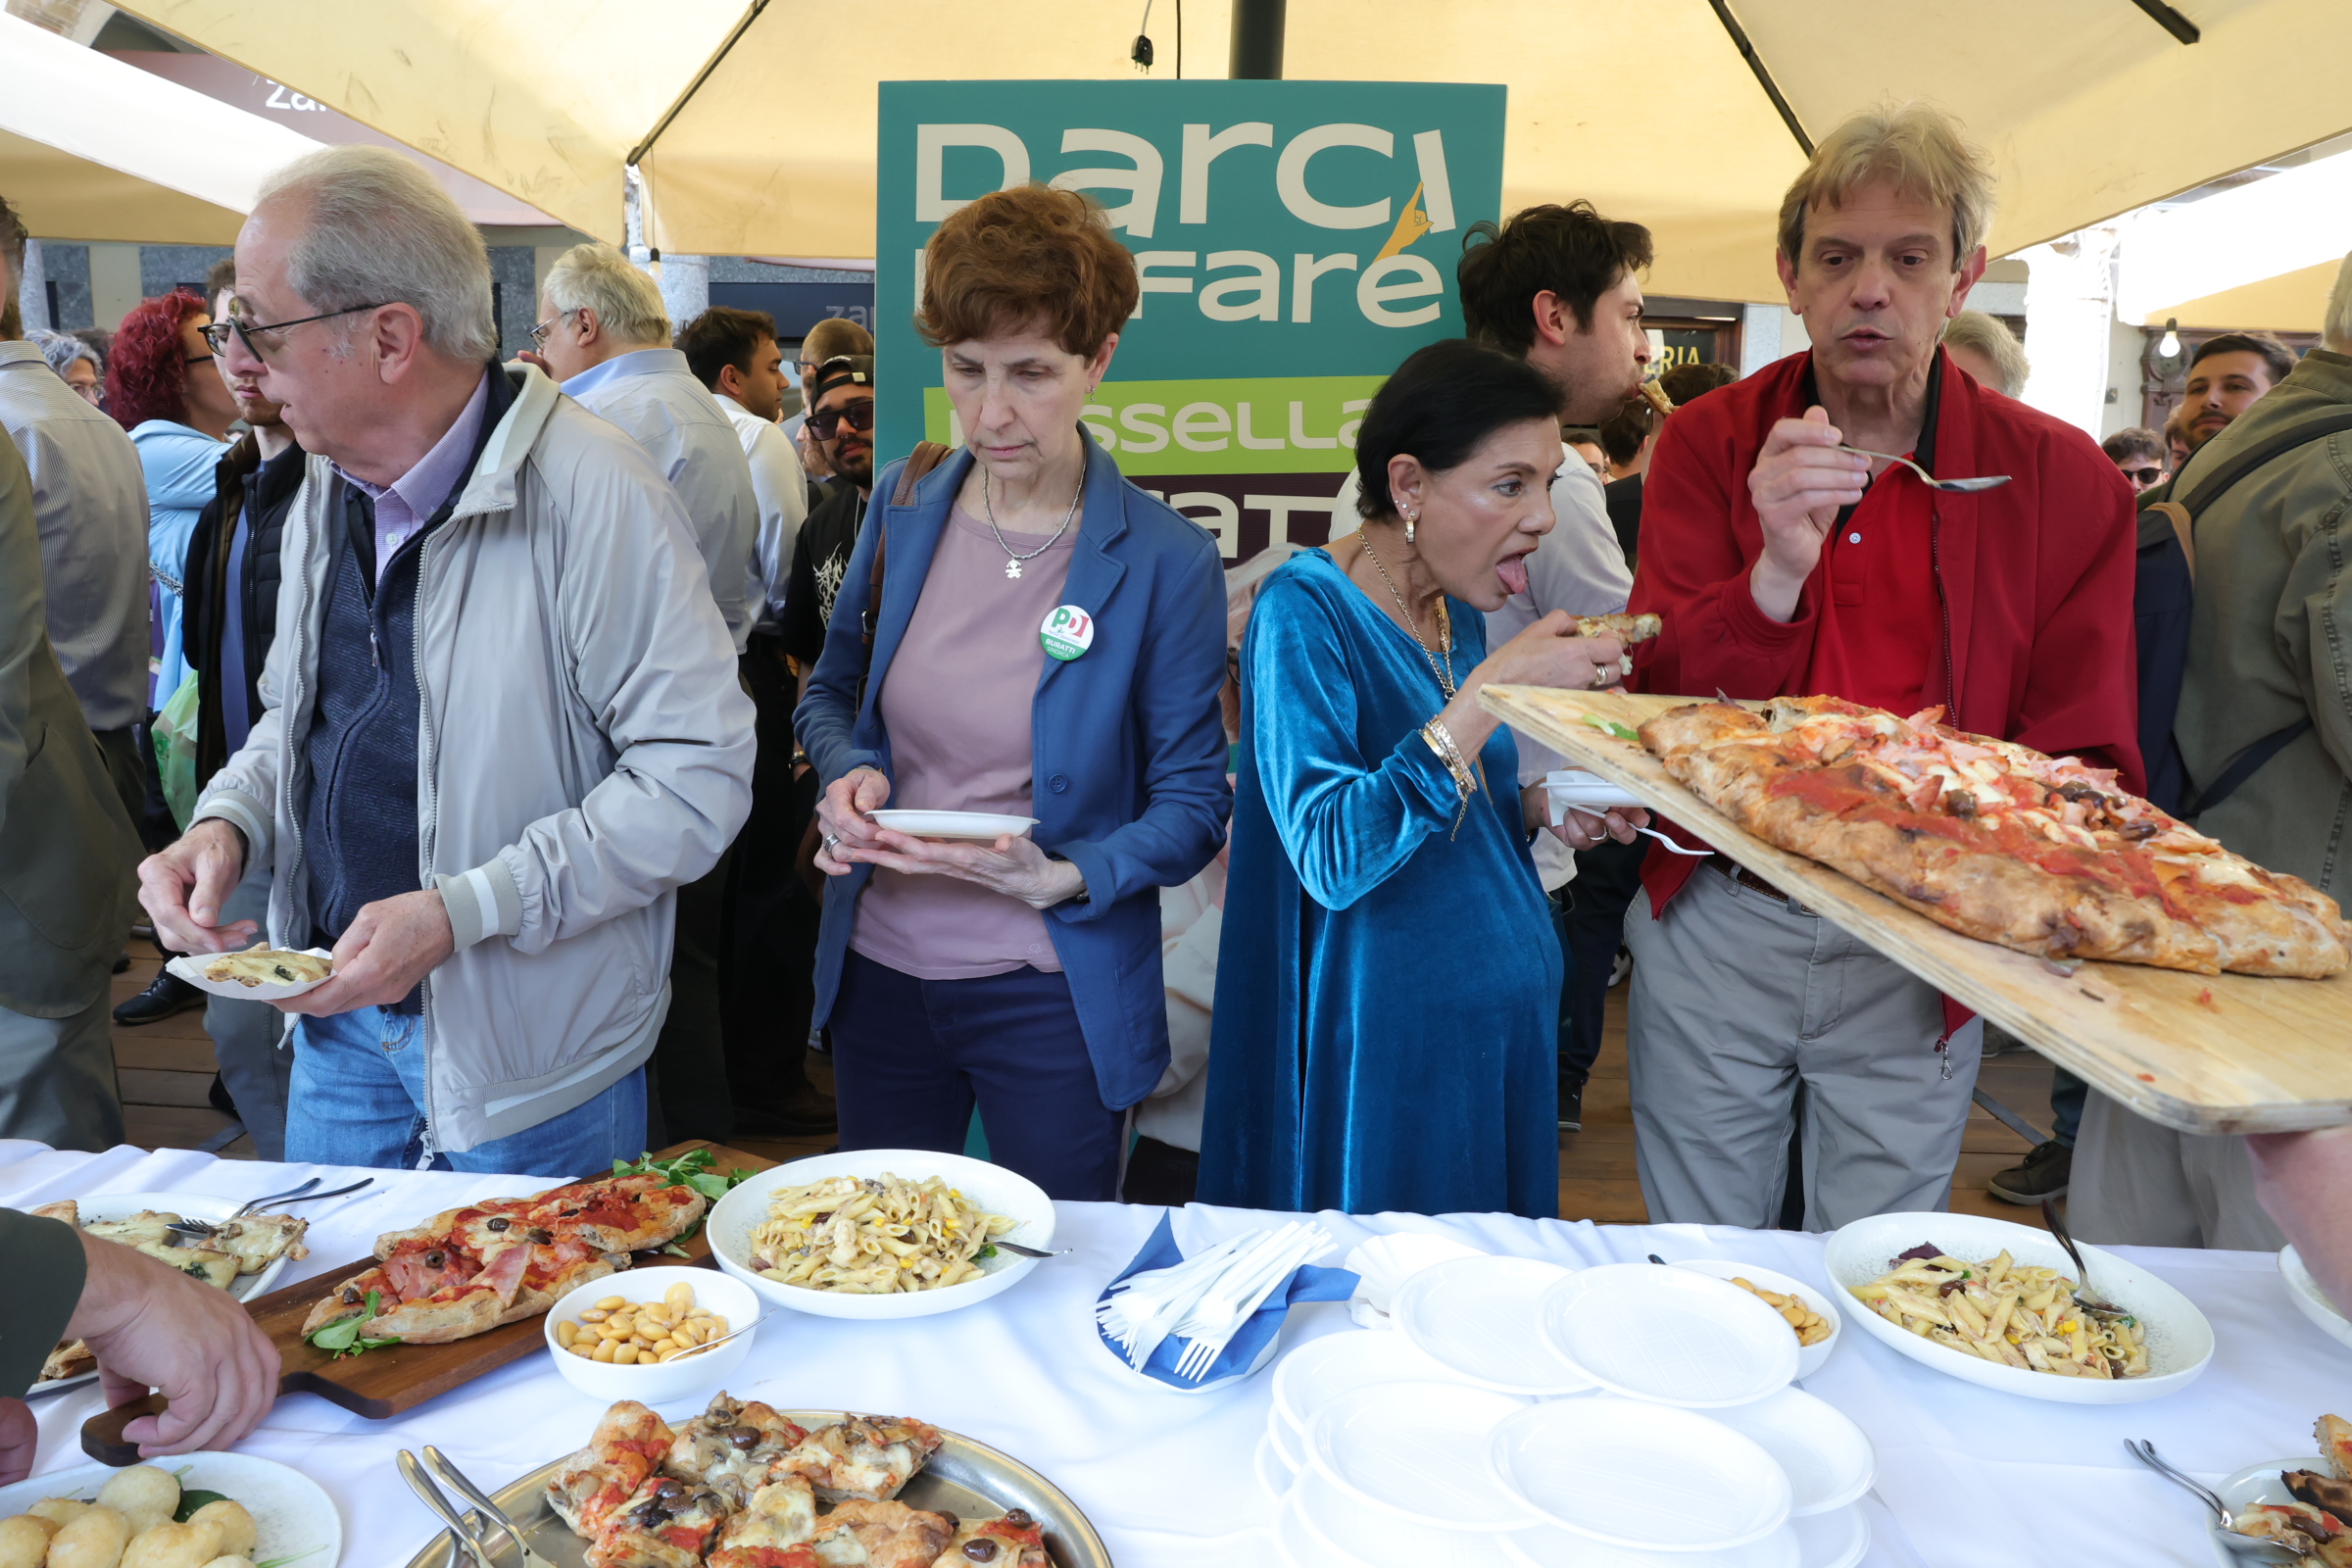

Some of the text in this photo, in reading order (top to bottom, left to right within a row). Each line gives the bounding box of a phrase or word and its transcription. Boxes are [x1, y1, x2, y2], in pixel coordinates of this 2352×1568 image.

[826, 306, 875, 330] za
[1051, 607, 1090, 638] PD
[1045, 638, 1076, 655] BURATTI
[1047, 646, 1070, 659] SINDACA
